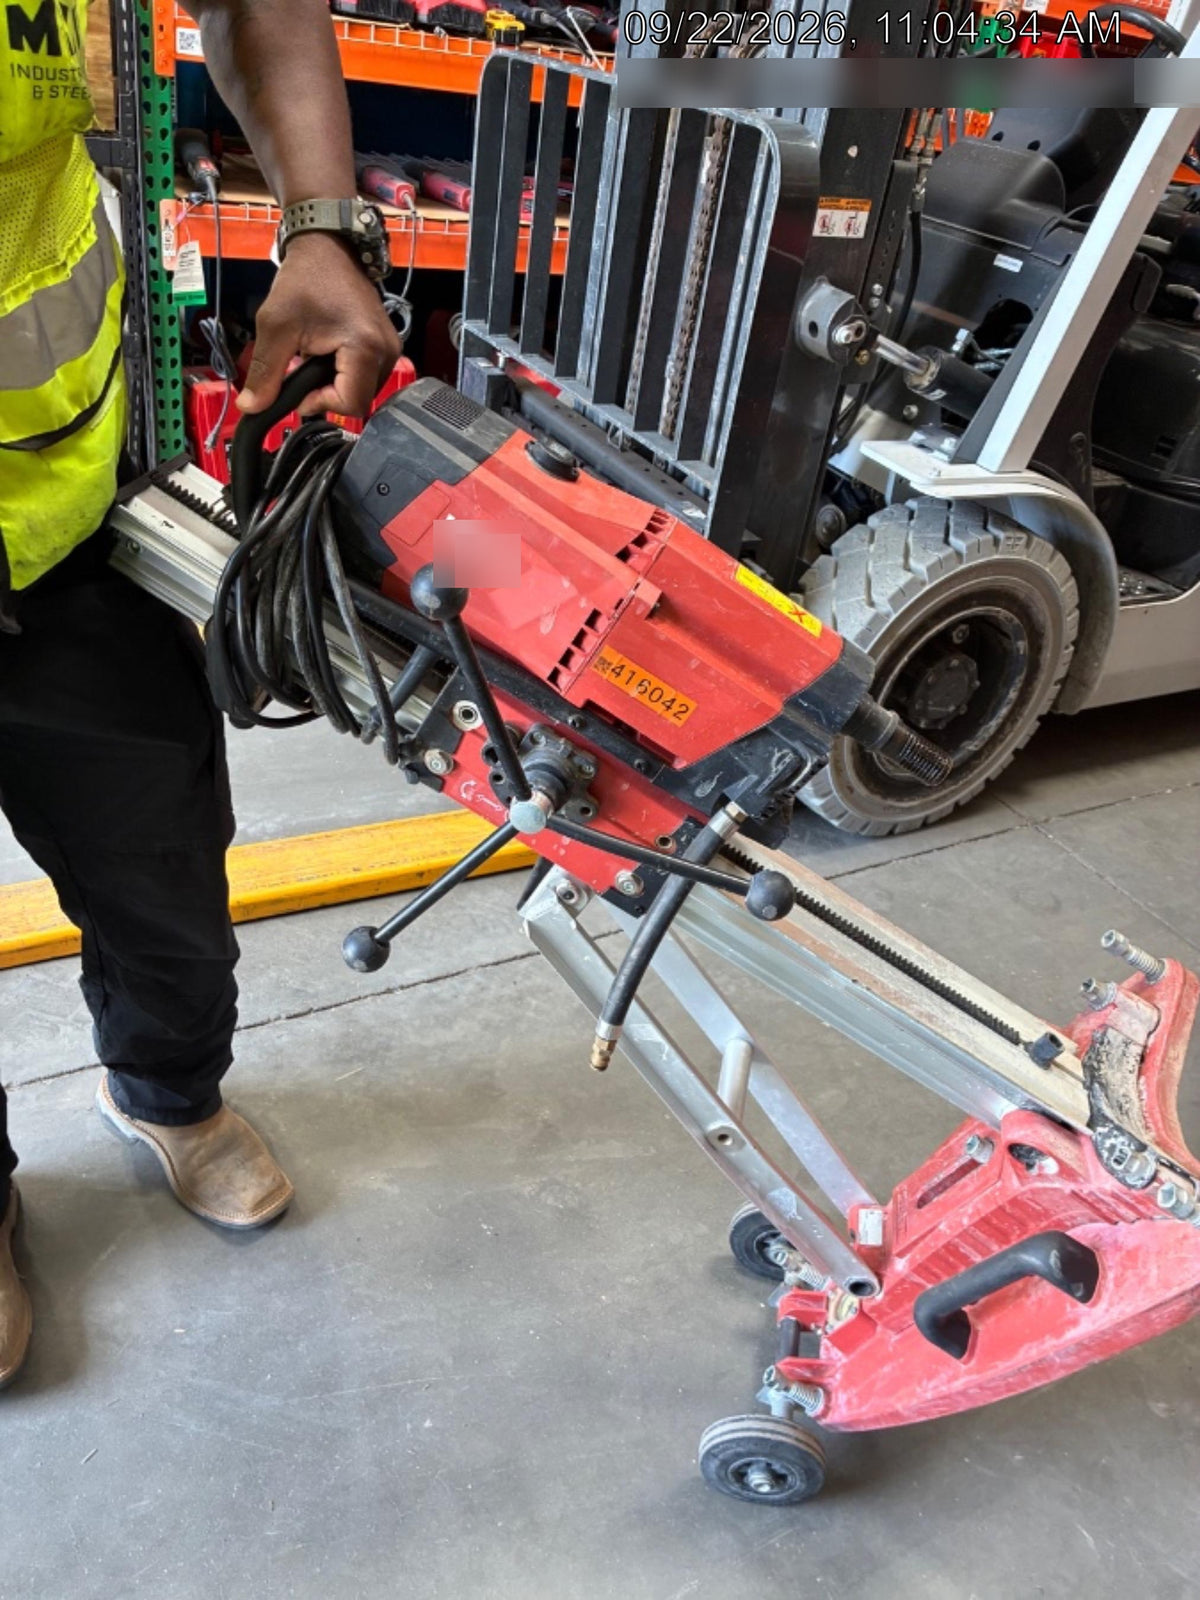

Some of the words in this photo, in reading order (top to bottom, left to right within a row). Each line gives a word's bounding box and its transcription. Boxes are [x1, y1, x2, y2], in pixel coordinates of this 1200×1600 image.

[9, 62, 82, 82] INDUST
[33, 84, 44, 99] &
[611, 664, 690, 721] 416042
